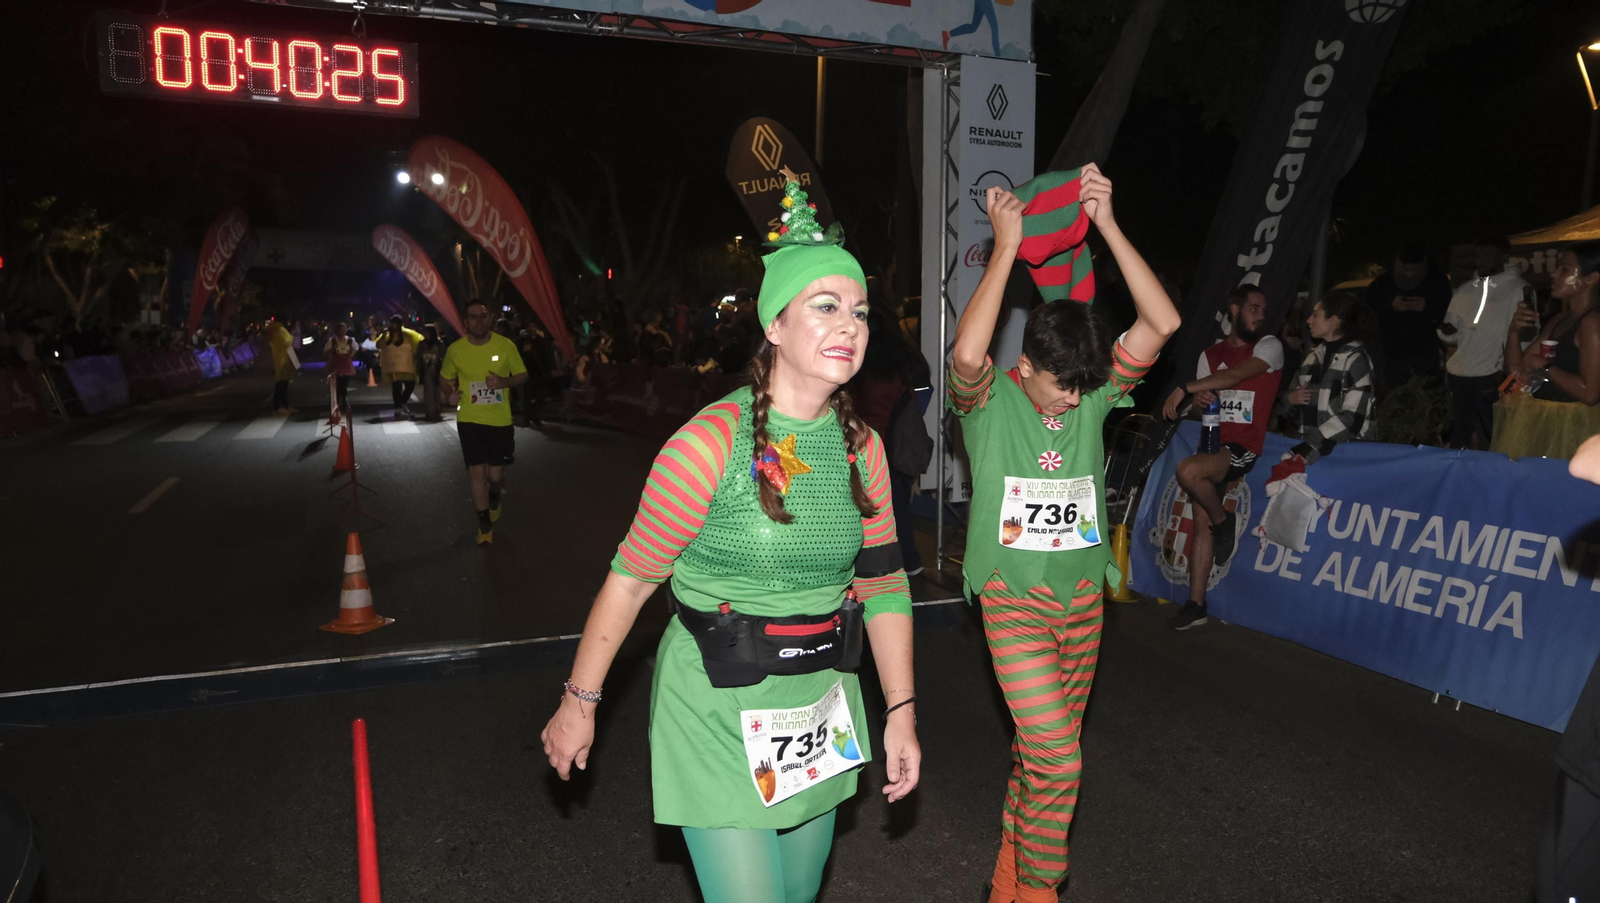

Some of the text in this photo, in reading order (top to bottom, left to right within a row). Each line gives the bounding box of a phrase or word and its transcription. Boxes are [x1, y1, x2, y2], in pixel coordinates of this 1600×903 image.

[969, 126, 1023, 140] RENAULT
[969, 137, 1022, 149] SYRSA AUTOMOCION
[200, 212, 245, 290] Coca-Cola
[477, 389, 495, 397] 174
[1026, 481, 1039, 489] XIV
[1041, 481, 1057, 490] SAN
[1025, 503, 1078, 525] 736
[1307, 500, 1600, 592] YUNTAMIEN
[1254, 541, 1523, 640] DE ALMERÍA
[771, 709, 811, 721] XIV SAN
[771, 720, 808, 730] CIUDAD
[771, 719, 828, 762] 735
[780, 747, 827, 774] ISABEL ORTEGA
